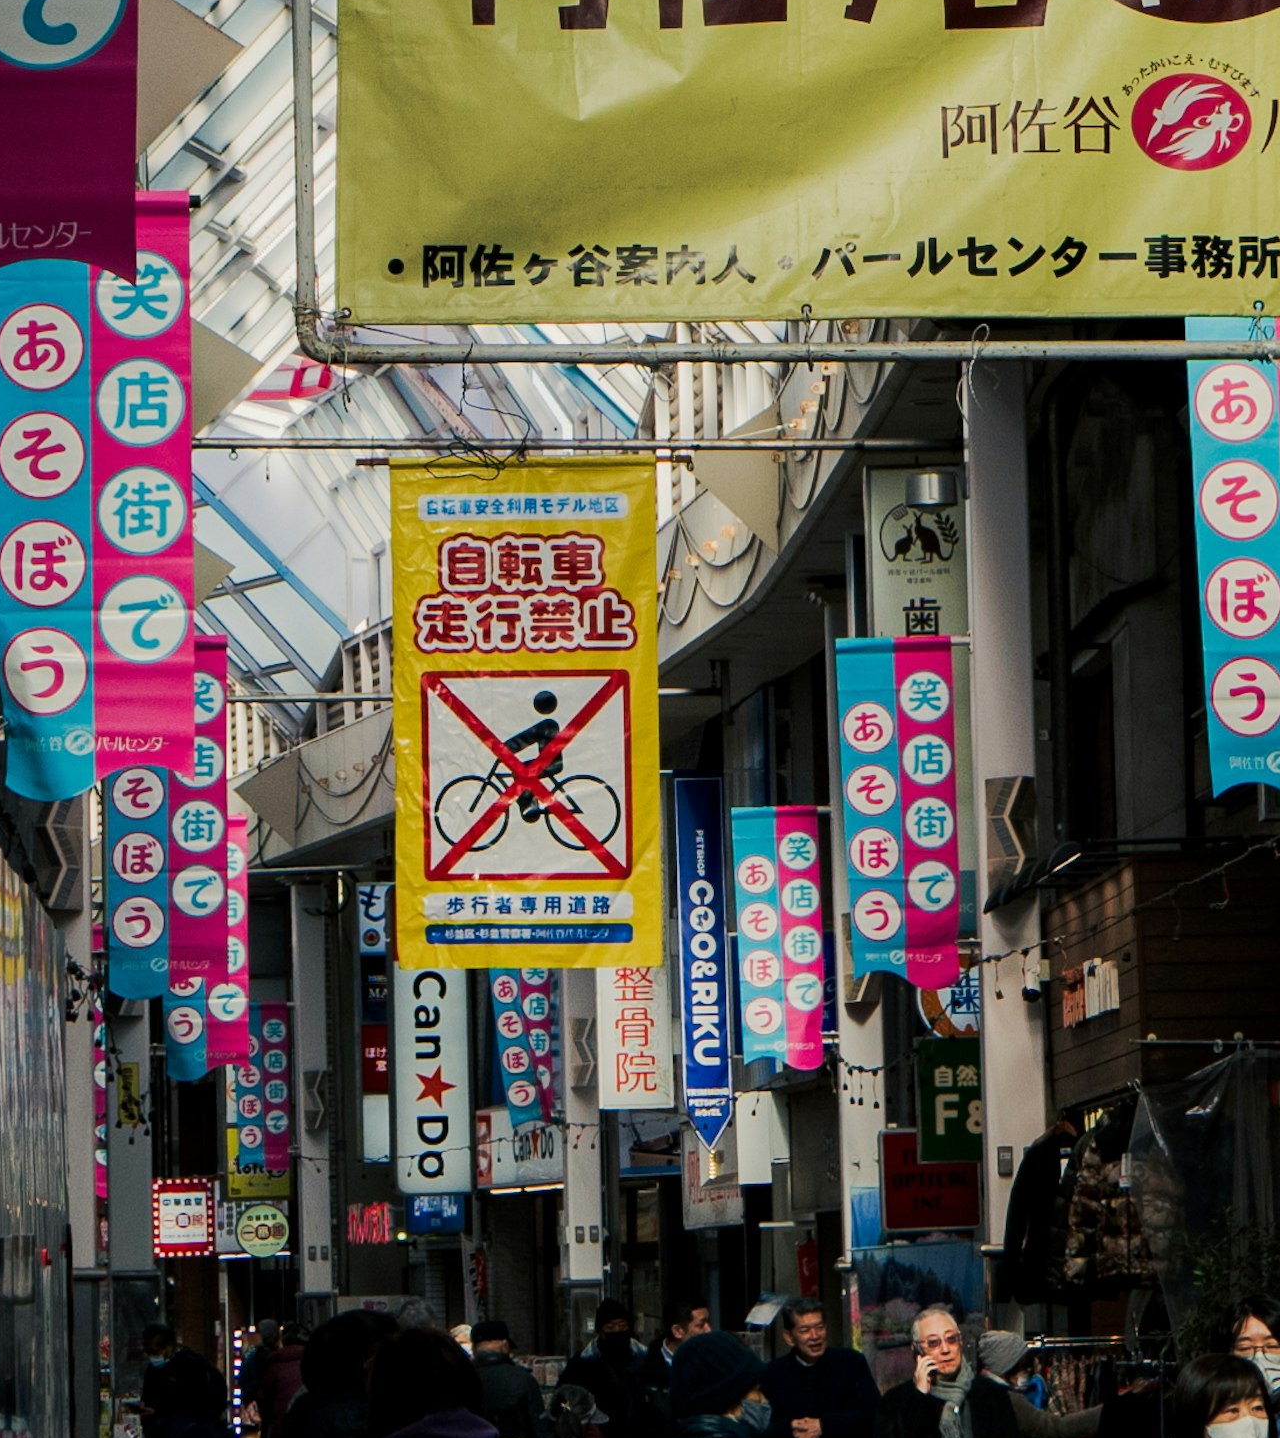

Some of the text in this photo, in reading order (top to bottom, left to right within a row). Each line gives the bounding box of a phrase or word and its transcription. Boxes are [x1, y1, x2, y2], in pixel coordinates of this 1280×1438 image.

[940, 97, 1120, 161] 阿佐谷
[12, 319, 73, 700] あそぼう
[111, 266, 176, 651] 笑店街で
[426, 496, 620, 516] 自転車安全利用モデル地区
[422, 597, 628, 644] 走行禁止
[447, 540, 596, 587] 自転車
[1210, 378, 1269, 721] あそぼう
[851, 707, 893, 934] あそぼう
[907, 676, 949, 906] 笑店街で
[447, 895, 612, 916] 歩行者専用道路
[745, 863, 774, 1028] あそぼう
[785, 832, 819, 1006] 笑店街で
[266, 1022, 284, 1132] 笑店街で
[613, 967, 658, 1094] 整骨院
